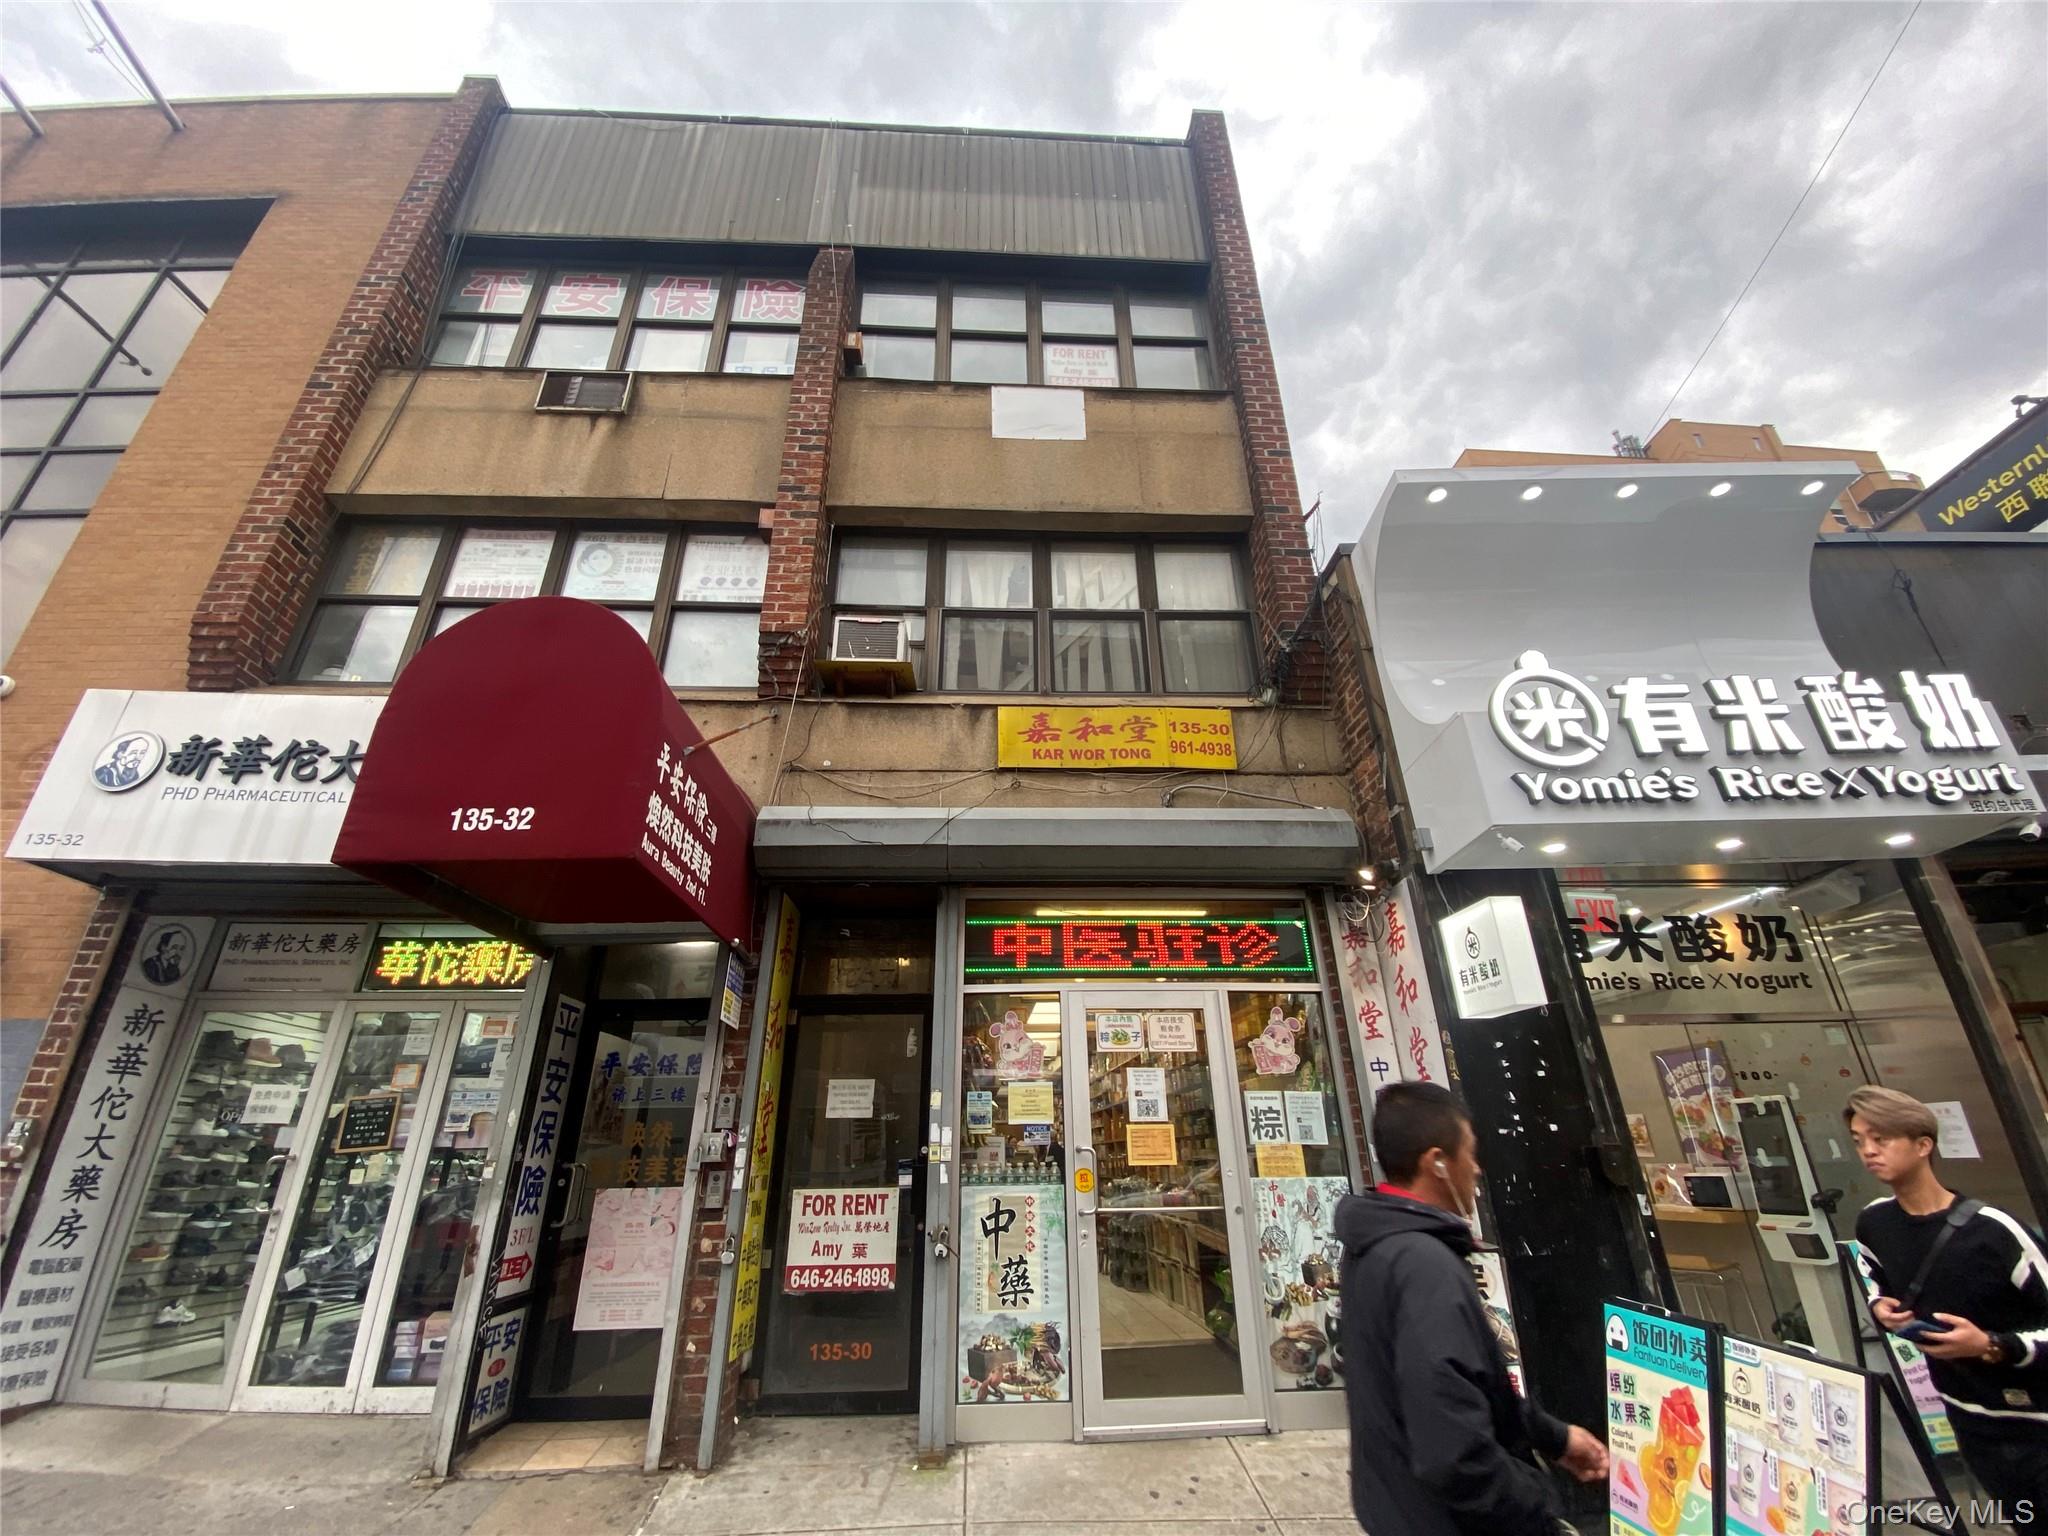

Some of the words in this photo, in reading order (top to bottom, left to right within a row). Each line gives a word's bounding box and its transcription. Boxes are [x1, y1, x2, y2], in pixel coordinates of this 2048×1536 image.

[460, 268, 806, 321] 平安保險
[1053, 347, 1074, 359] FOR
[1079, 349, 1106, 360] RENT
[1609, 670, 2001, 756] 有米酸奶
[1017, 711, 1158, 744] 嘉和堂
[1168, 721, 1230, 736] 135-30
[1032, 748, 1064, 760] KAR
[1070, 748, 1105, 761] WOR
[1110, 748, 1151, 760] TONG
[1170, 740, 1232, 757] 961-4938
[161, 787, 199, 800] PHD
[203, 787, 347, 803] PHARMACEUTICAL
[1513, 767, 1700, 801] Yomie's
[450, 807, 535, 831] 135-32
[25, 833, 84, 846] 135-32
[642, 832, 660, 862] Aura
[661, 851, 685, 886] Beauty
[686, 875, 697, 897] 2nd
[228, 932, 361, 954] 新華佗大藥房
[993, 922, 1279, 968] 中医驻诊
[1384, 902, 1432, 1082] 嘉和堂
[1651, 971, 1705, 991] Rice
[1732, 971, 1812, 994] Yogurt
[1370, 1057, 1389, 1081] 中
[515, 1002, 580, 1216] 平安保險
[38, 1003, 166, 1249] 新華佗大藥房
[1251, 1106, 1284, 1140] 粽
[802, 1194, 835, 1216] FOR
[842, 1194, 889, 1216] RENT
[811, 1240, 842, 1260] Amy
[852, 1244, 868, 1259] 葉
[980, 1197, 1034, 1307] 中藥
[790, 1267, 889, 1288] 646-246-1898
[810, 1343, 872, 1361] 135-30
[1633, 1320, 1707, 1365] 饭团外卖
[1634, 1347, 1668, 1368] Fantuan
[1670, 1360, 1707, 1384] Delivery
[1610, 1373, 1635, 1395] 缤纷
[1610, 1400, 1651, 1427] 水果茶
[1611, 1427, 1633, 1440] Colorful
